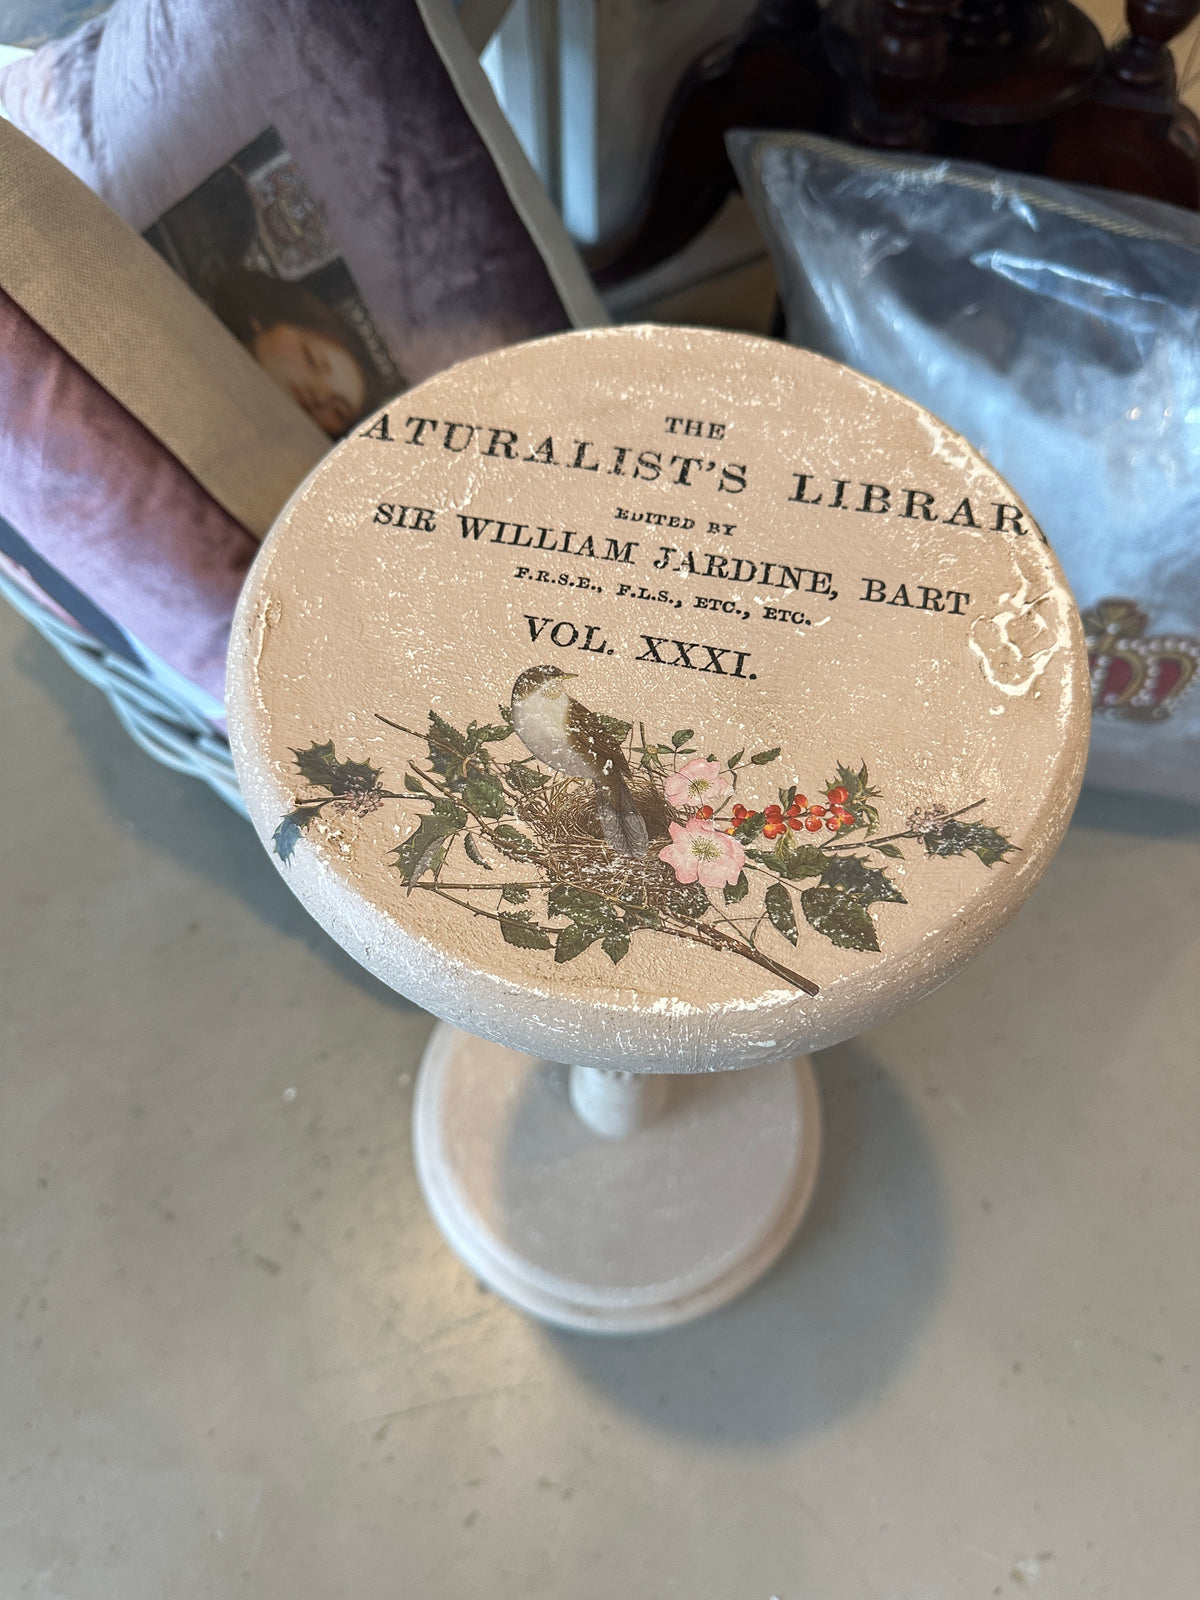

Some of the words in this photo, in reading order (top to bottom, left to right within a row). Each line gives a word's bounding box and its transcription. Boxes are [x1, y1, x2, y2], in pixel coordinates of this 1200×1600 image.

[665, 416, 726, 440] THE
[614, 507, 695, 530] EDITED
[706, 522, 737, 537] BY
[373, 503, 437, 532] SIR
[456, 514, 639, 565] WILLIAM
[653, 546, 839, 601] JARDINE,
[859, 577, 970, 616] BART
[514, 566, 603, 593] F.R.S.E.,
[616, 583, 682, 608] F.L.S.,
[693, 596, 750, 620] ETC.,
[763, 606, 812, 626] ETC.
[523, 614, 615, 656] VOL.
[635, 634, 757, 680] XXXI.
